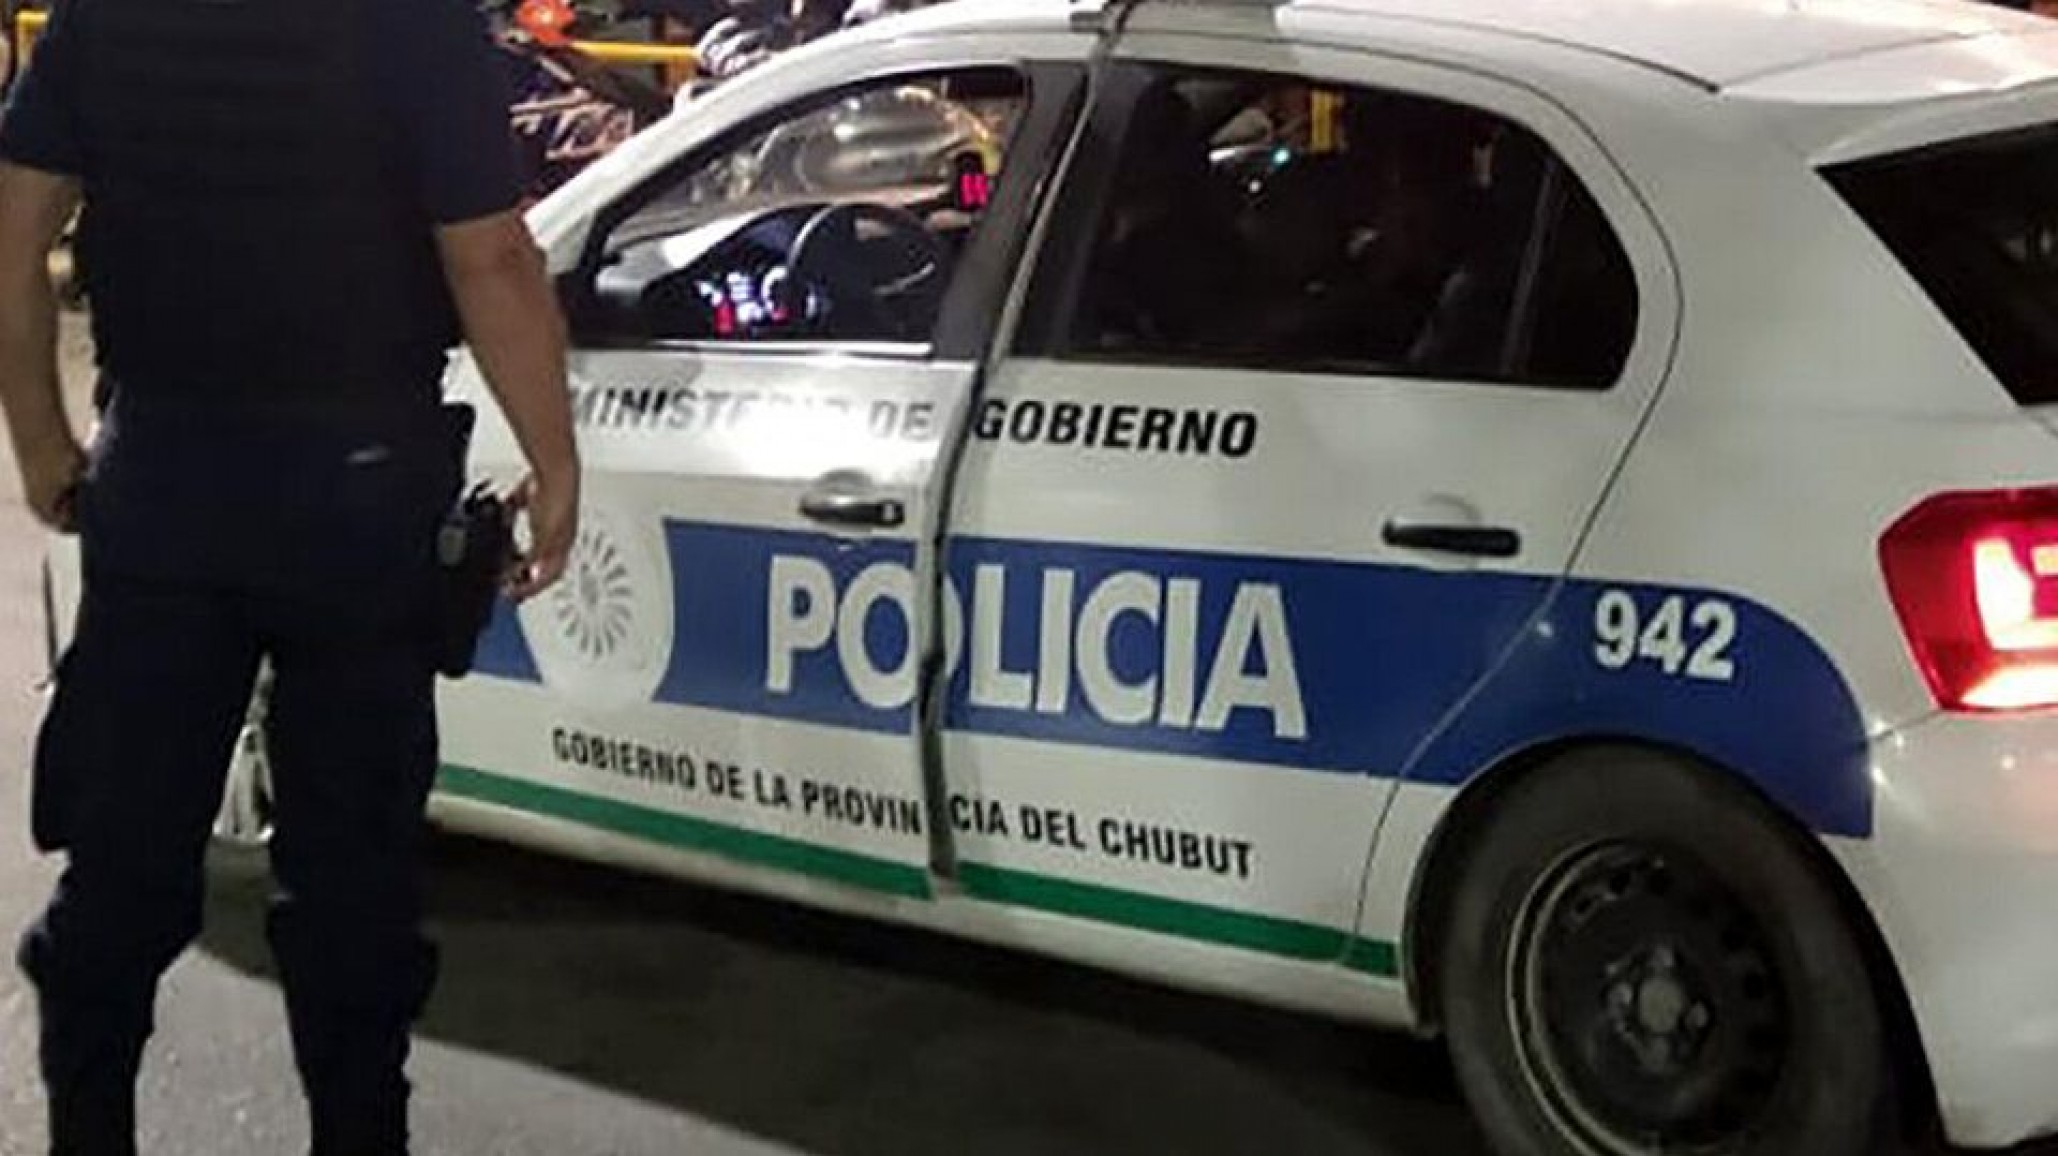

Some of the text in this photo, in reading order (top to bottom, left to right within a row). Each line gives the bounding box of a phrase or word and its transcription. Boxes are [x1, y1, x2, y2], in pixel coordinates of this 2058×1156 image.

[569, 386, 1257, 458] MINIST DE GOBIERNO
[766, 554, 1307, 739] POLICIA
[1595, 590, 1737, 681] 942
[553, 727, 1252, 879] GOBIERNO DE LA PROVINCIA DEL CHUBUT
